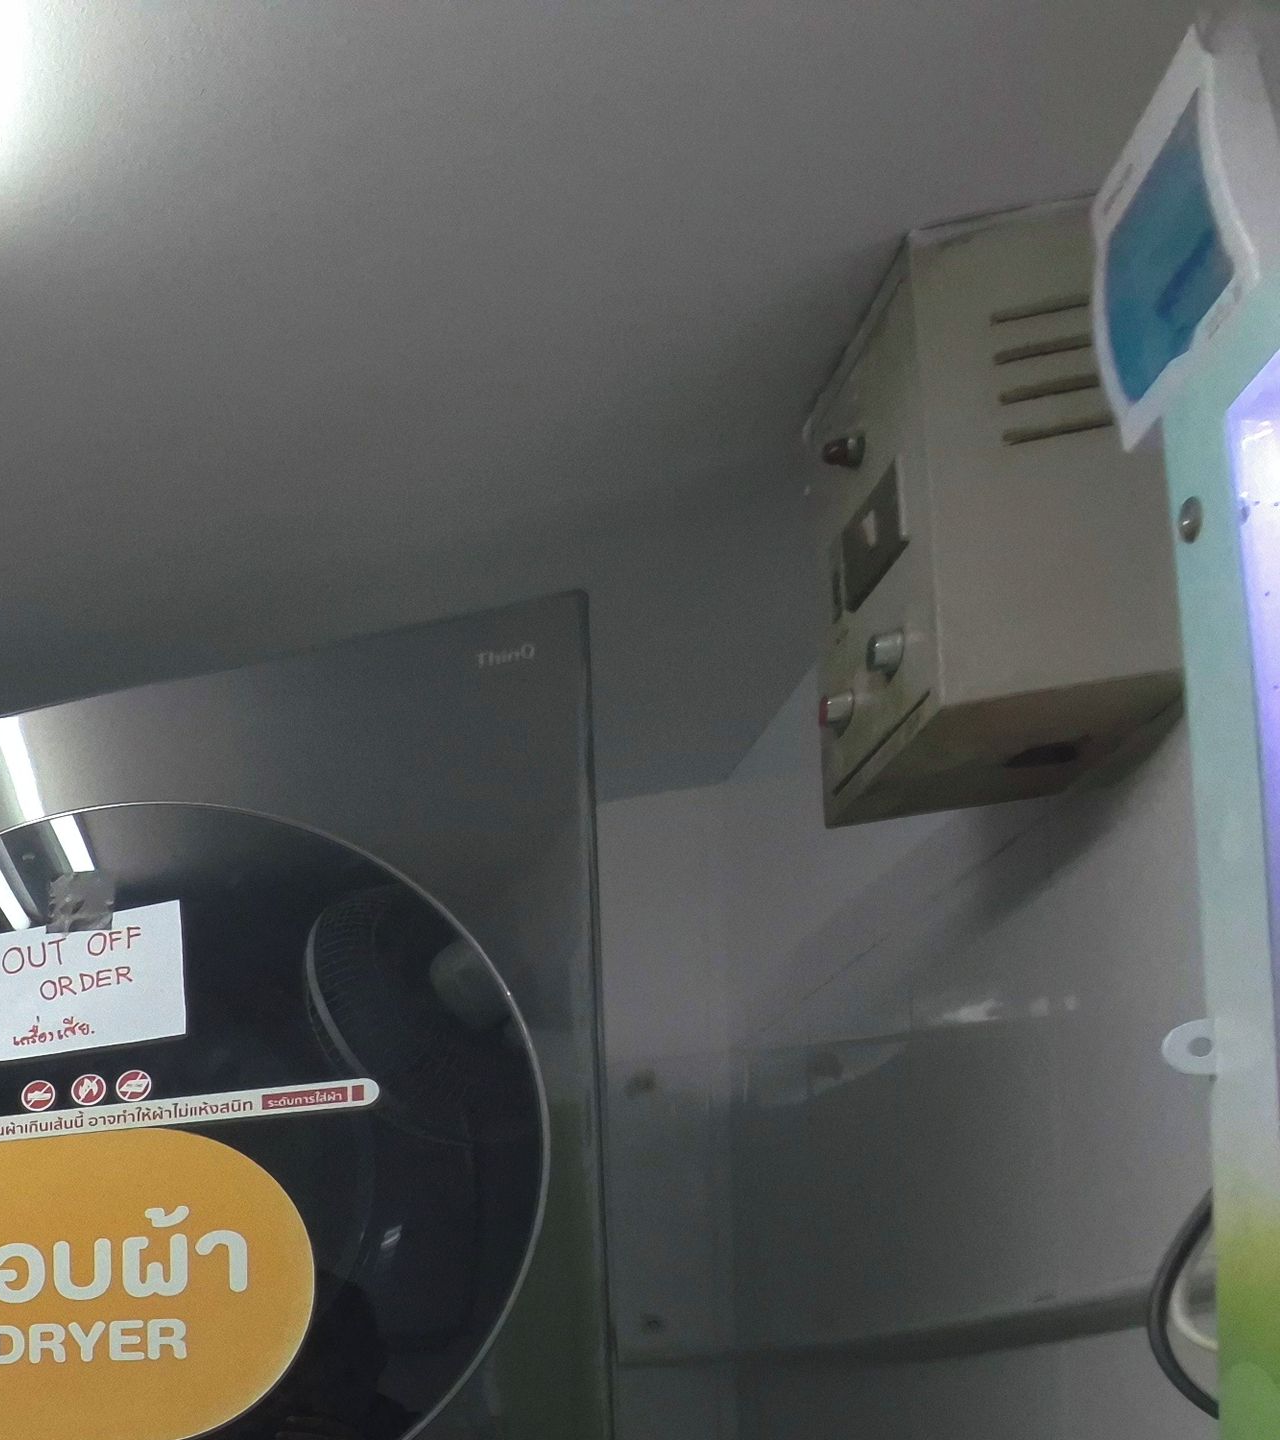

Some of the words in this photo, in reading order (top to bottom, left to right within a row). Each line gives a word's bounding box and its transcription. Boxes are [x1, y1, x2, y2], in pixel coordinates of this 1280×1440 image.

[477, 643, 535, 668] ThinQ
[2, 937, 66, 972] OUT
[87, 926, 142, 956] OFF
[39, 965, 134, 1002] ORDER
